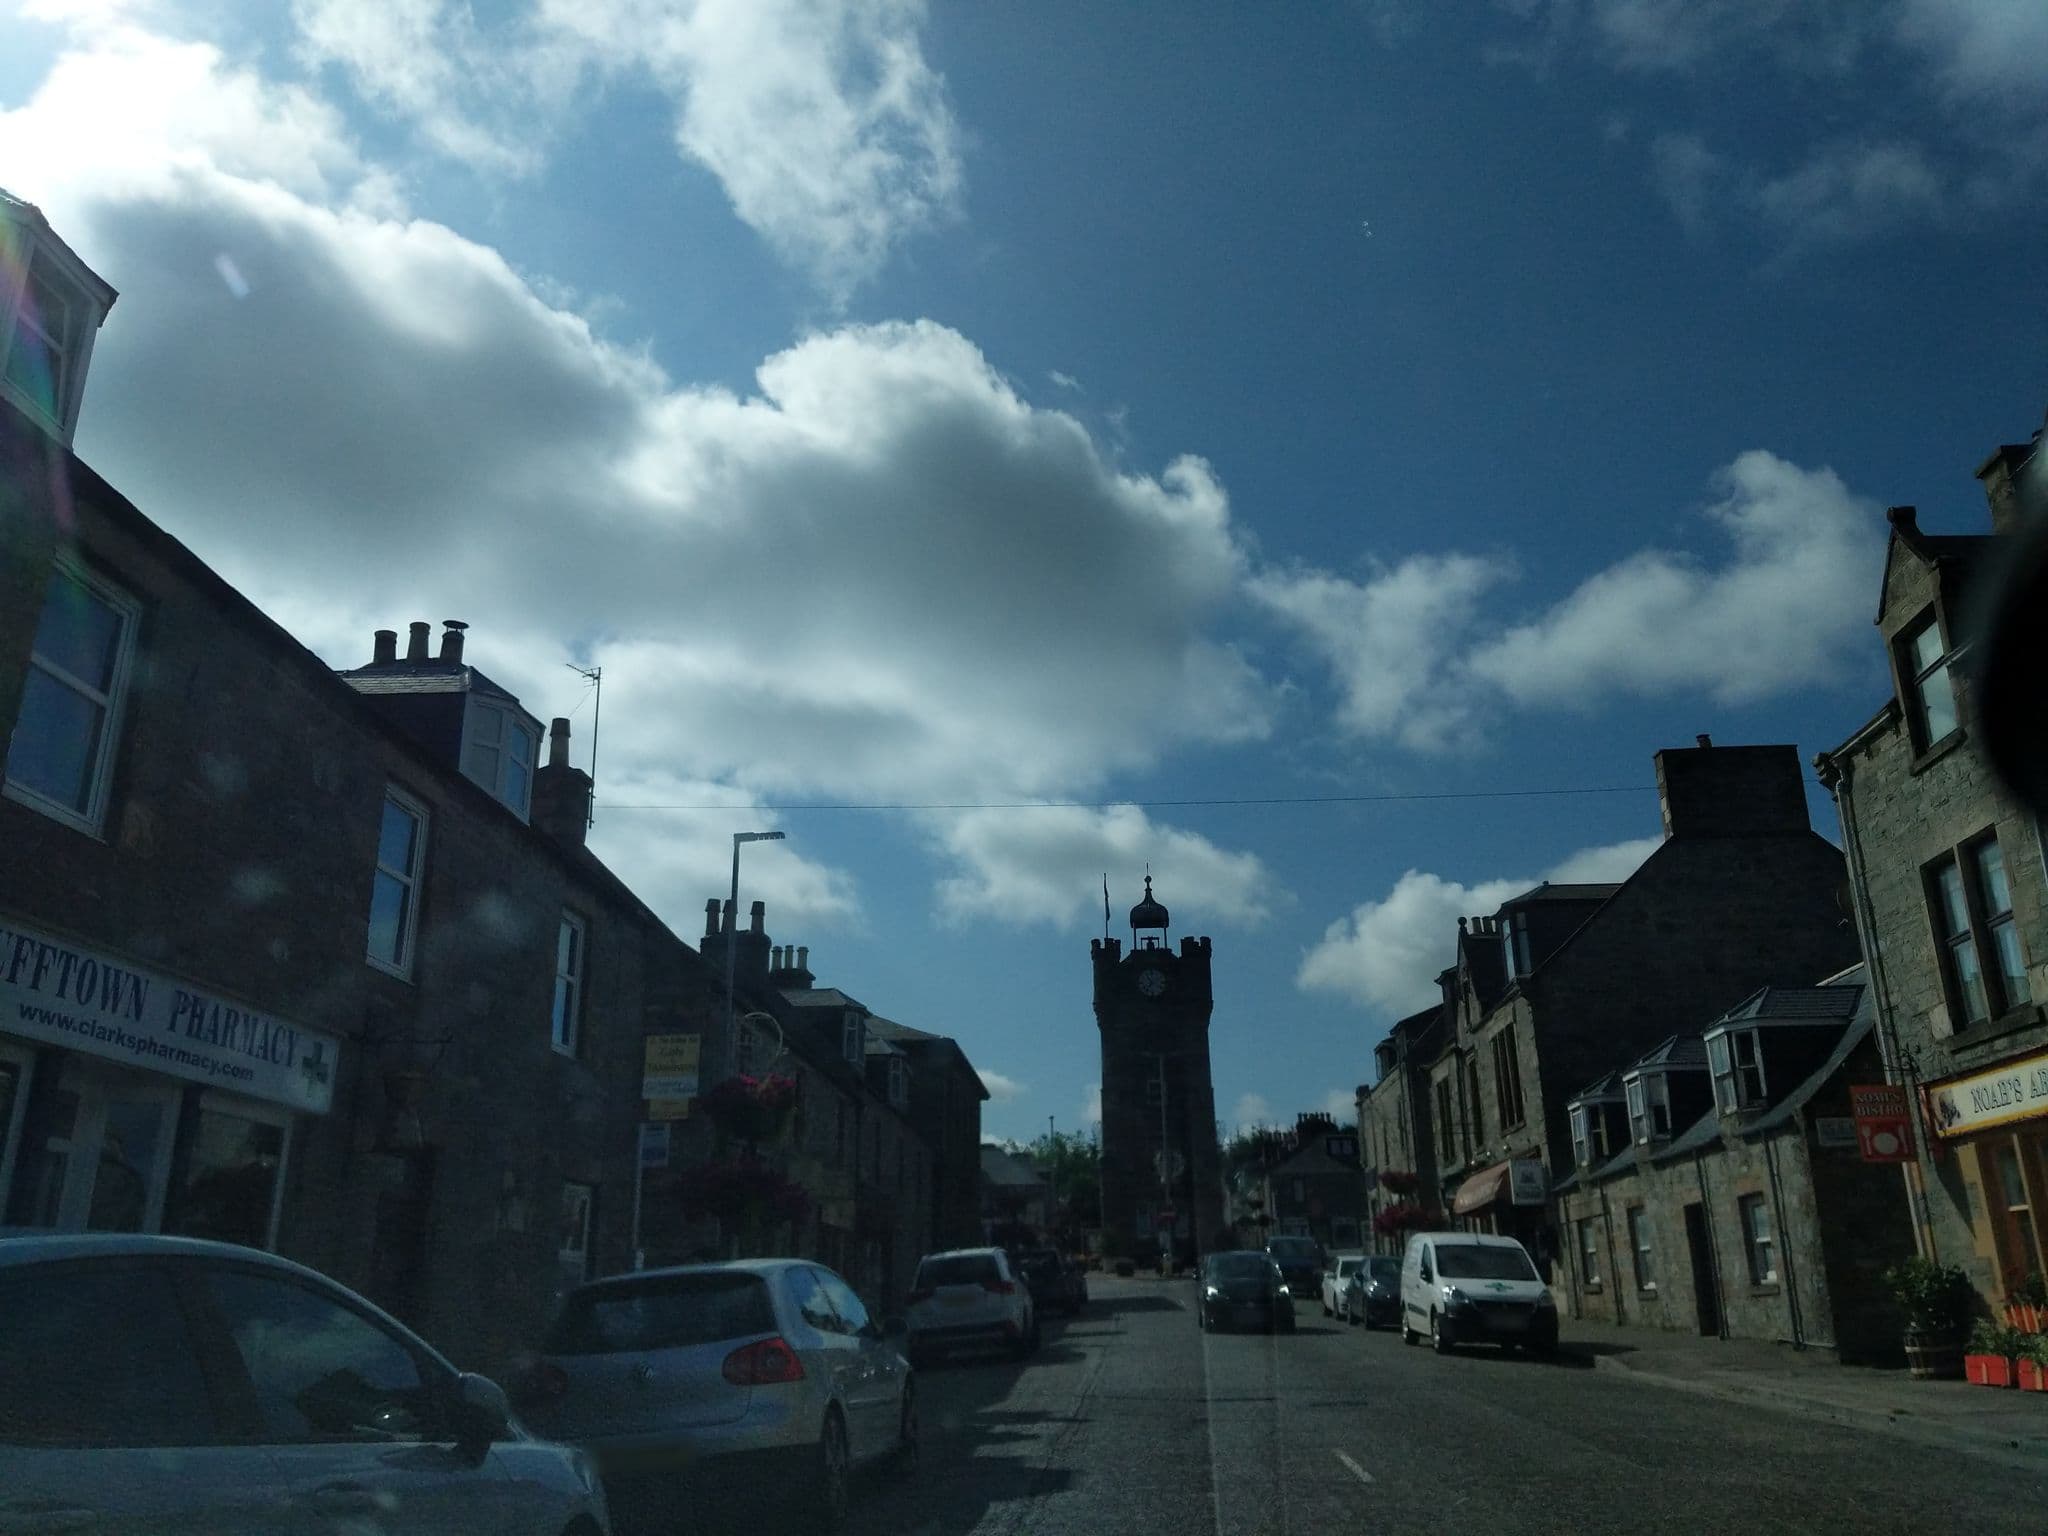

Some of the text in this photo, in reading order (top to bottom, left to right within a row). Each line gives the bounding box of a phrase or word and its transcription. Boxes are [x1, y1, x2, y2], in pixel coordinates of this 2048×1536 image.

[19, 1003, 255, 1081] www.clarkspharmacy.com
[168, 990, 302, 1066] PHARMACY
[1856, 1105, 1905, 1115] BISTRO
[1971, 1076, 2023, 1113] NOAH'S
